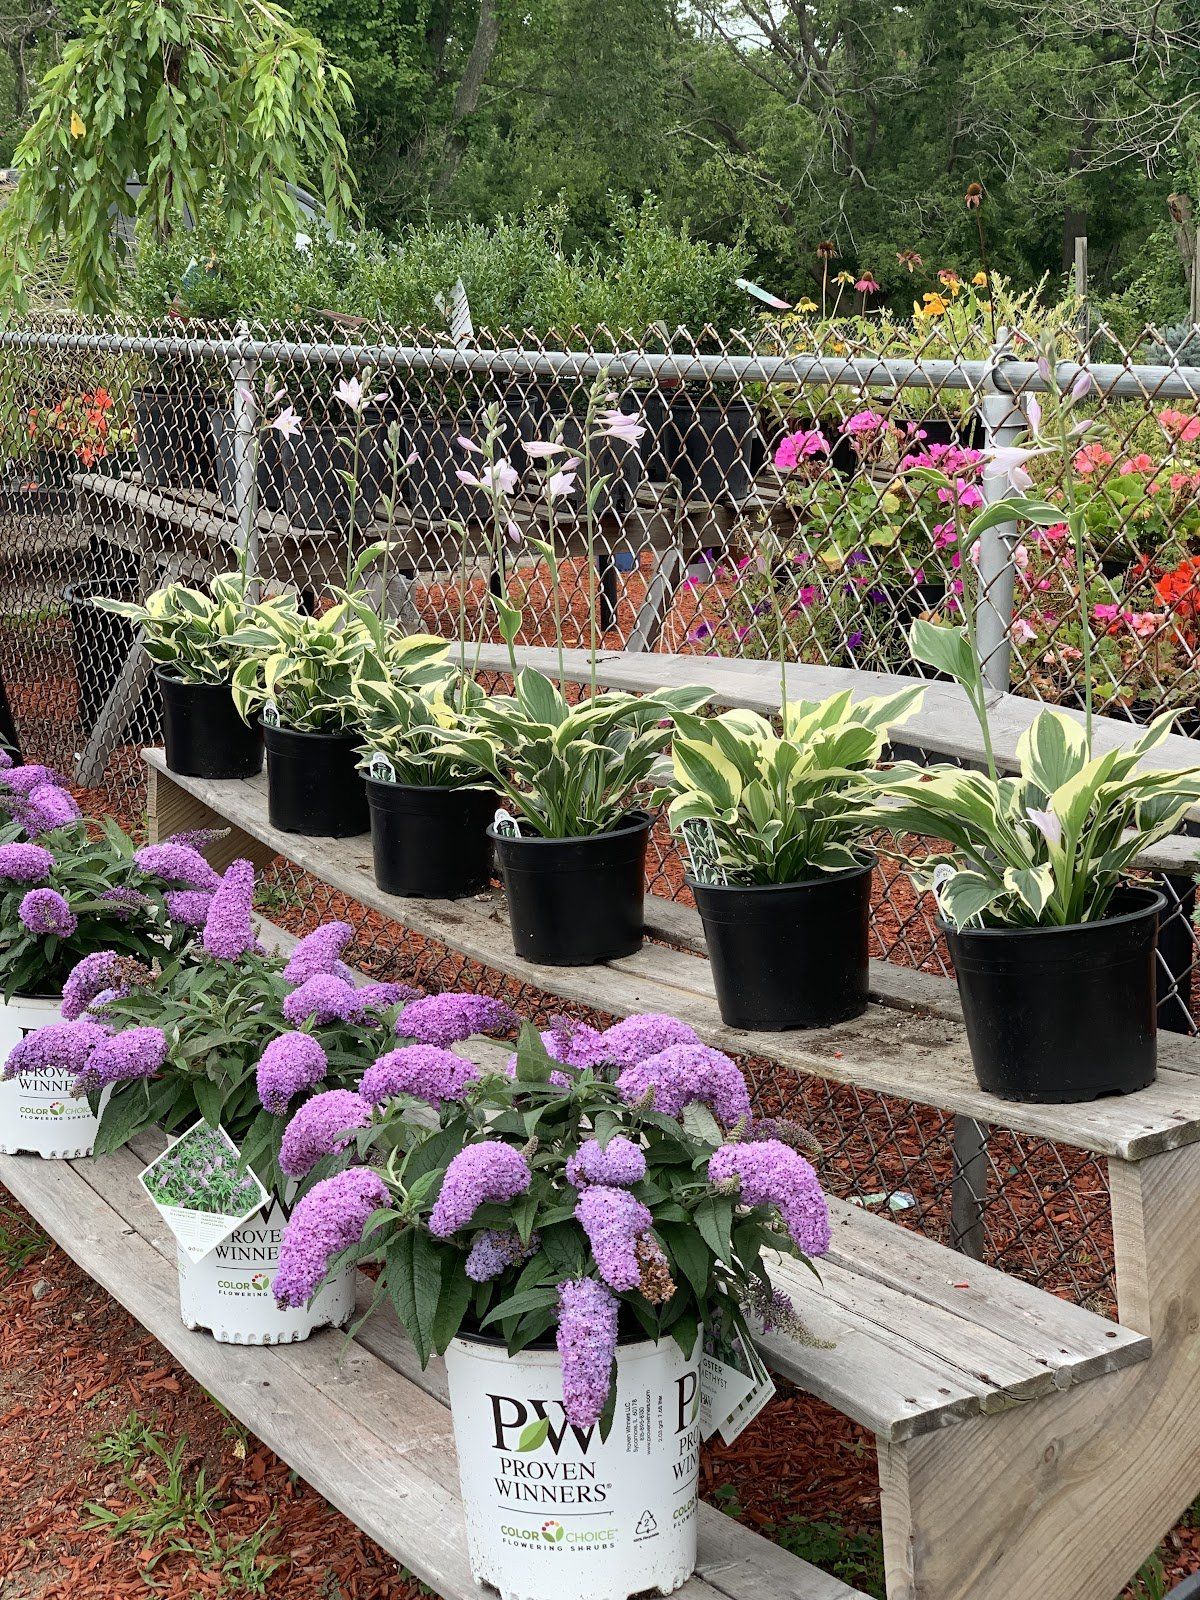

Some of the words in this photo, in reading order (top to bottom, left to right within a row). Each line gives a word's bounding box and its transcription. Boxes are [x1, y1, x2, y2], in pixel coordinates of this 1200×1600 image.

[19, 1078, 74, 1092] WINNE
[20, 1106, 48, 1115] COLOR
[65, 1106, 91, 1115] CHOIC
[215, 1246, 280, 1261] WINNE
[217, 1280, 250, 1291] COLOR
[218, 1289, 268, 1297] FLOWERING
[499, 1456, 597, 1481] PROVEN
[644, 1518, 650, 1528] 2
[500, 1525, 540, 1541] COLOR
[502, 1537, 563, 1552] FLOWERING
[570, 1542, 616, 1552] SHRUBS
